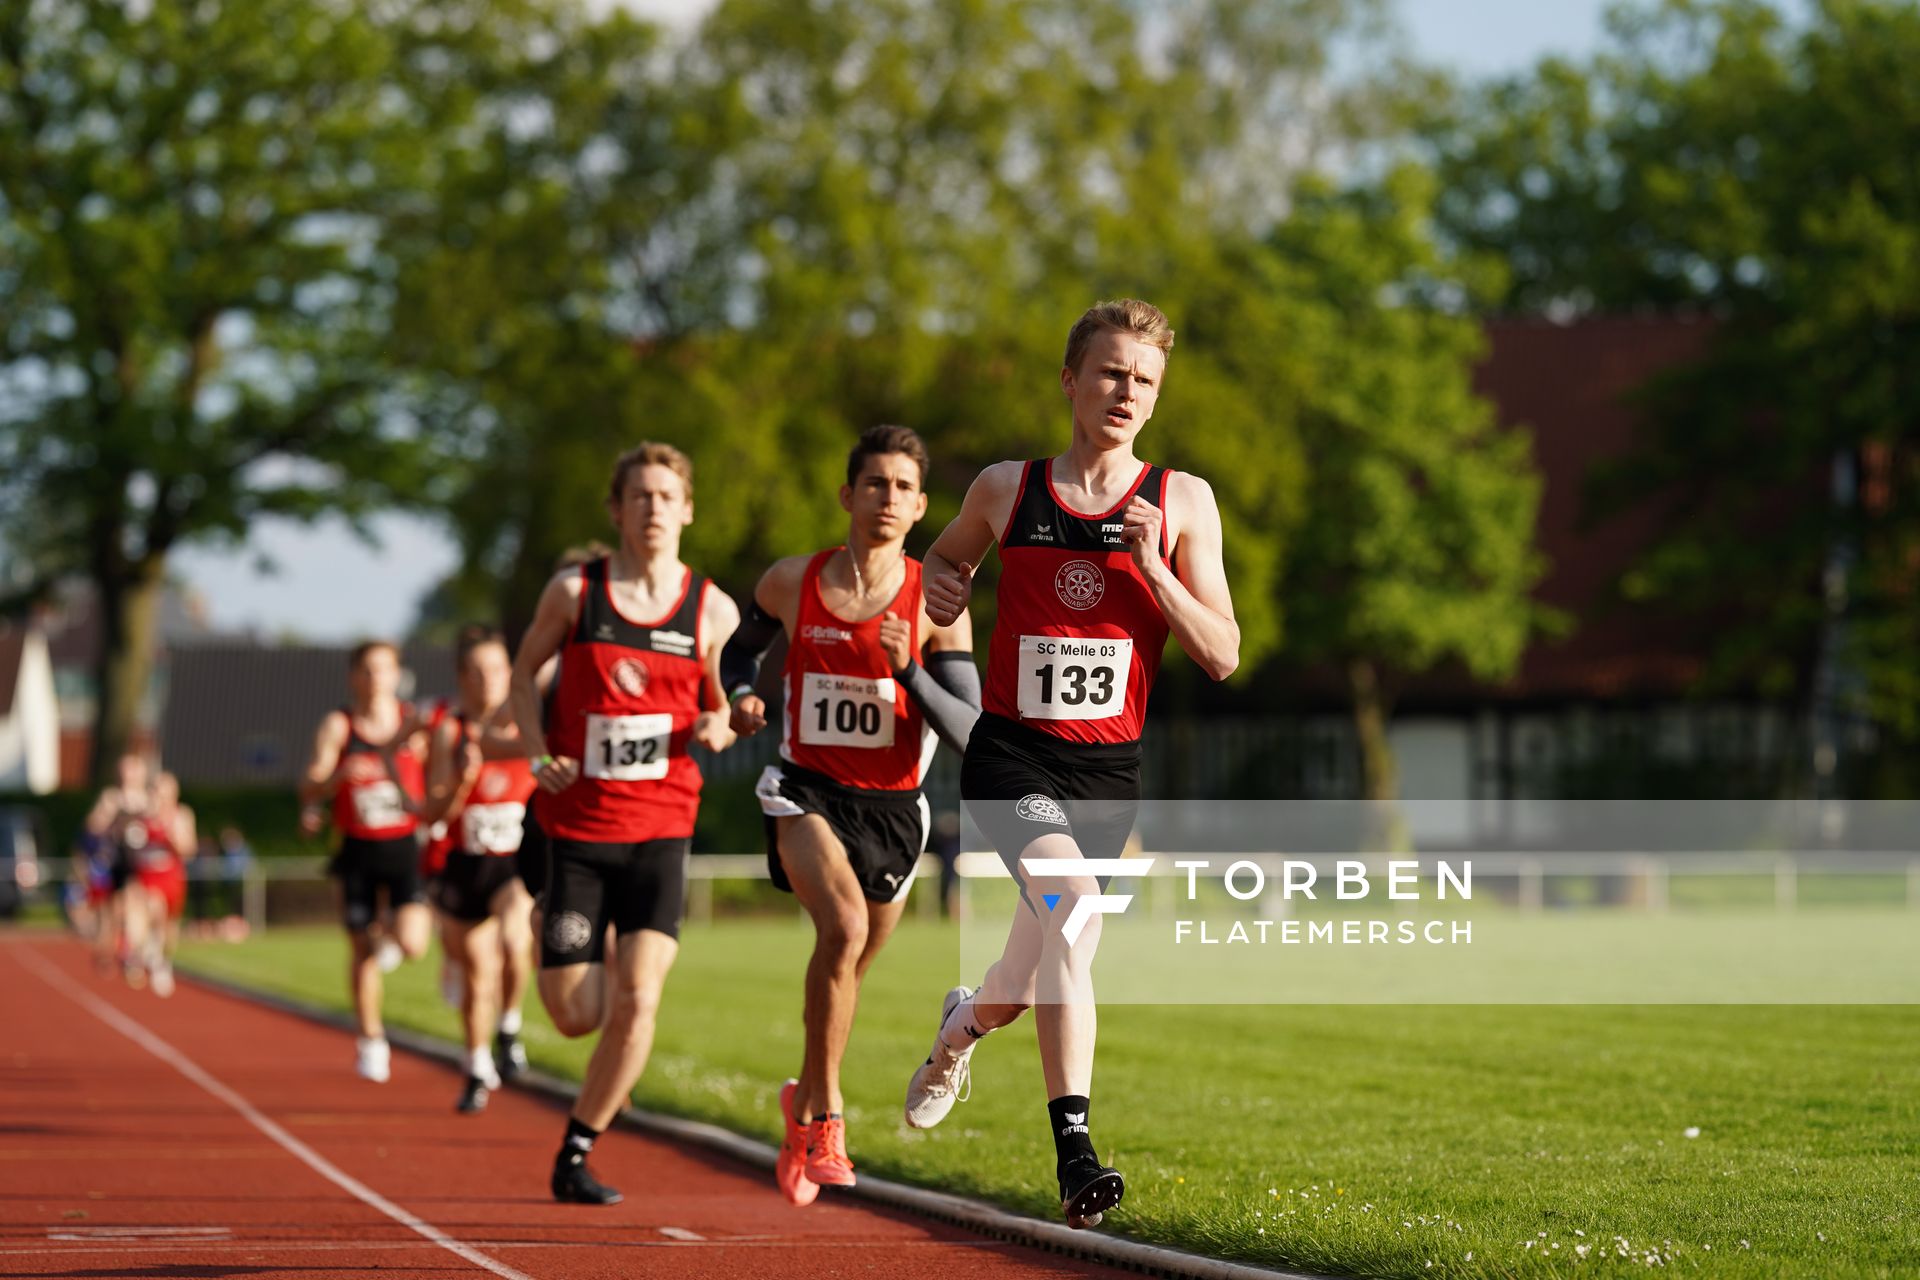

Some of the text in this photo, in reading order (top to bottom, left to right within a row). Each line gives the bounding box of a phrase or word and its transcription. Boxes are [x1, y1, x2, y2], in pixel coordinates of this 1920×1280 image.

[1103, 535, 1125, 544] Lau
[1037, 643, 1116, 657] SC Melle 03
[817, 680, 878, 695] SC Melle 03
[1035, 664, 1115, 706] 133
[814, 698, 881, 735] 100
[601, 738, 658, 766] 132
